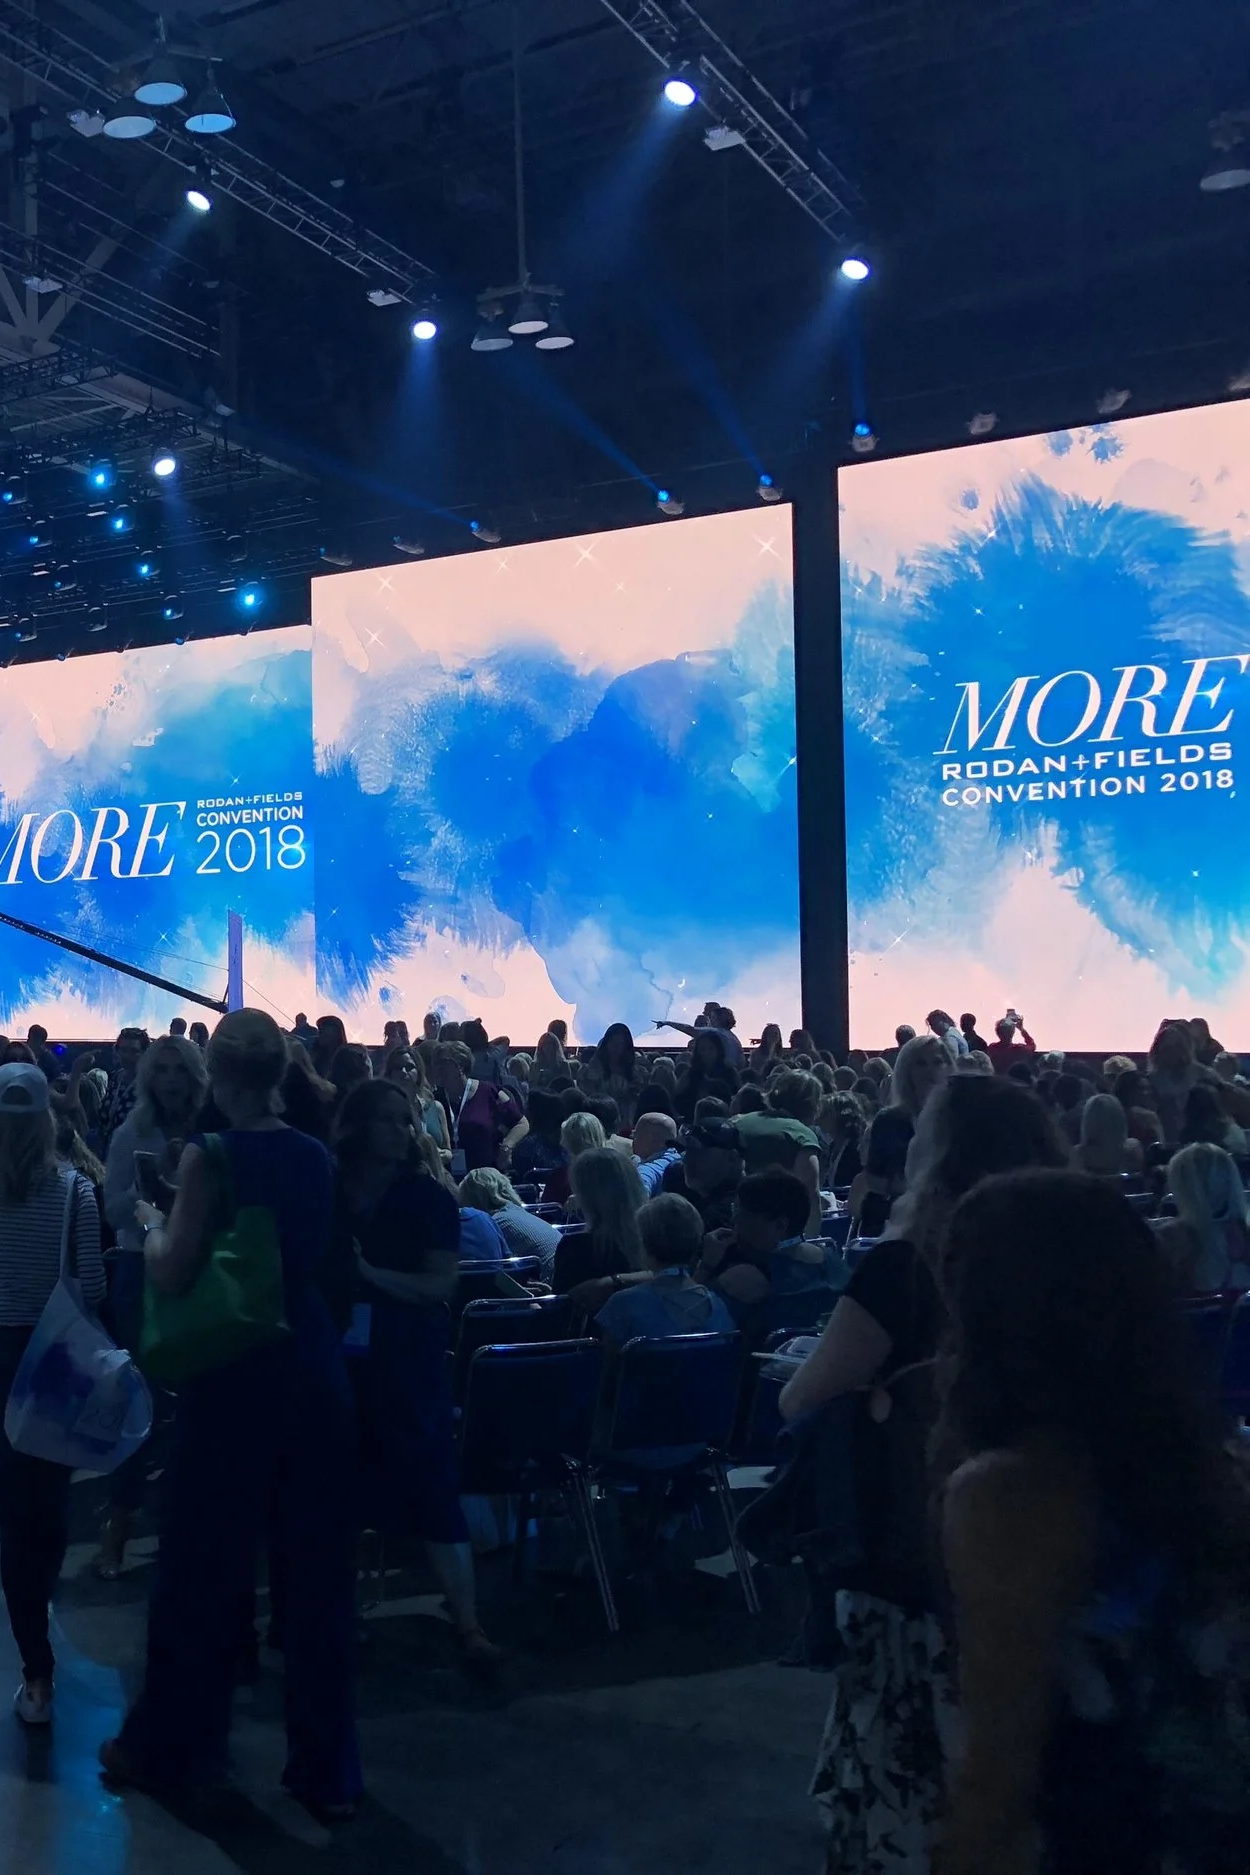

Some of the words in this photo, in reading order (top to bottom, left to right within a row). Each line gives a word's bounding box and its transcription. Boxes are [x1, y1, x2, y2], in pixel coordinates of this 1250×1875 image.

[933, 655, 1250, 755] MORE
[942, 743, 1233, 780] RODAN+FIELDS
[197, 791, 302, 809] RODAN+FIELDS
[942, 775, 1146, 806] CONVENTION
[1160, 769, 1234, 793] 2018
[196, 805, 303, 827] CONVENTION
[196, 824, 306, 874] 2018
